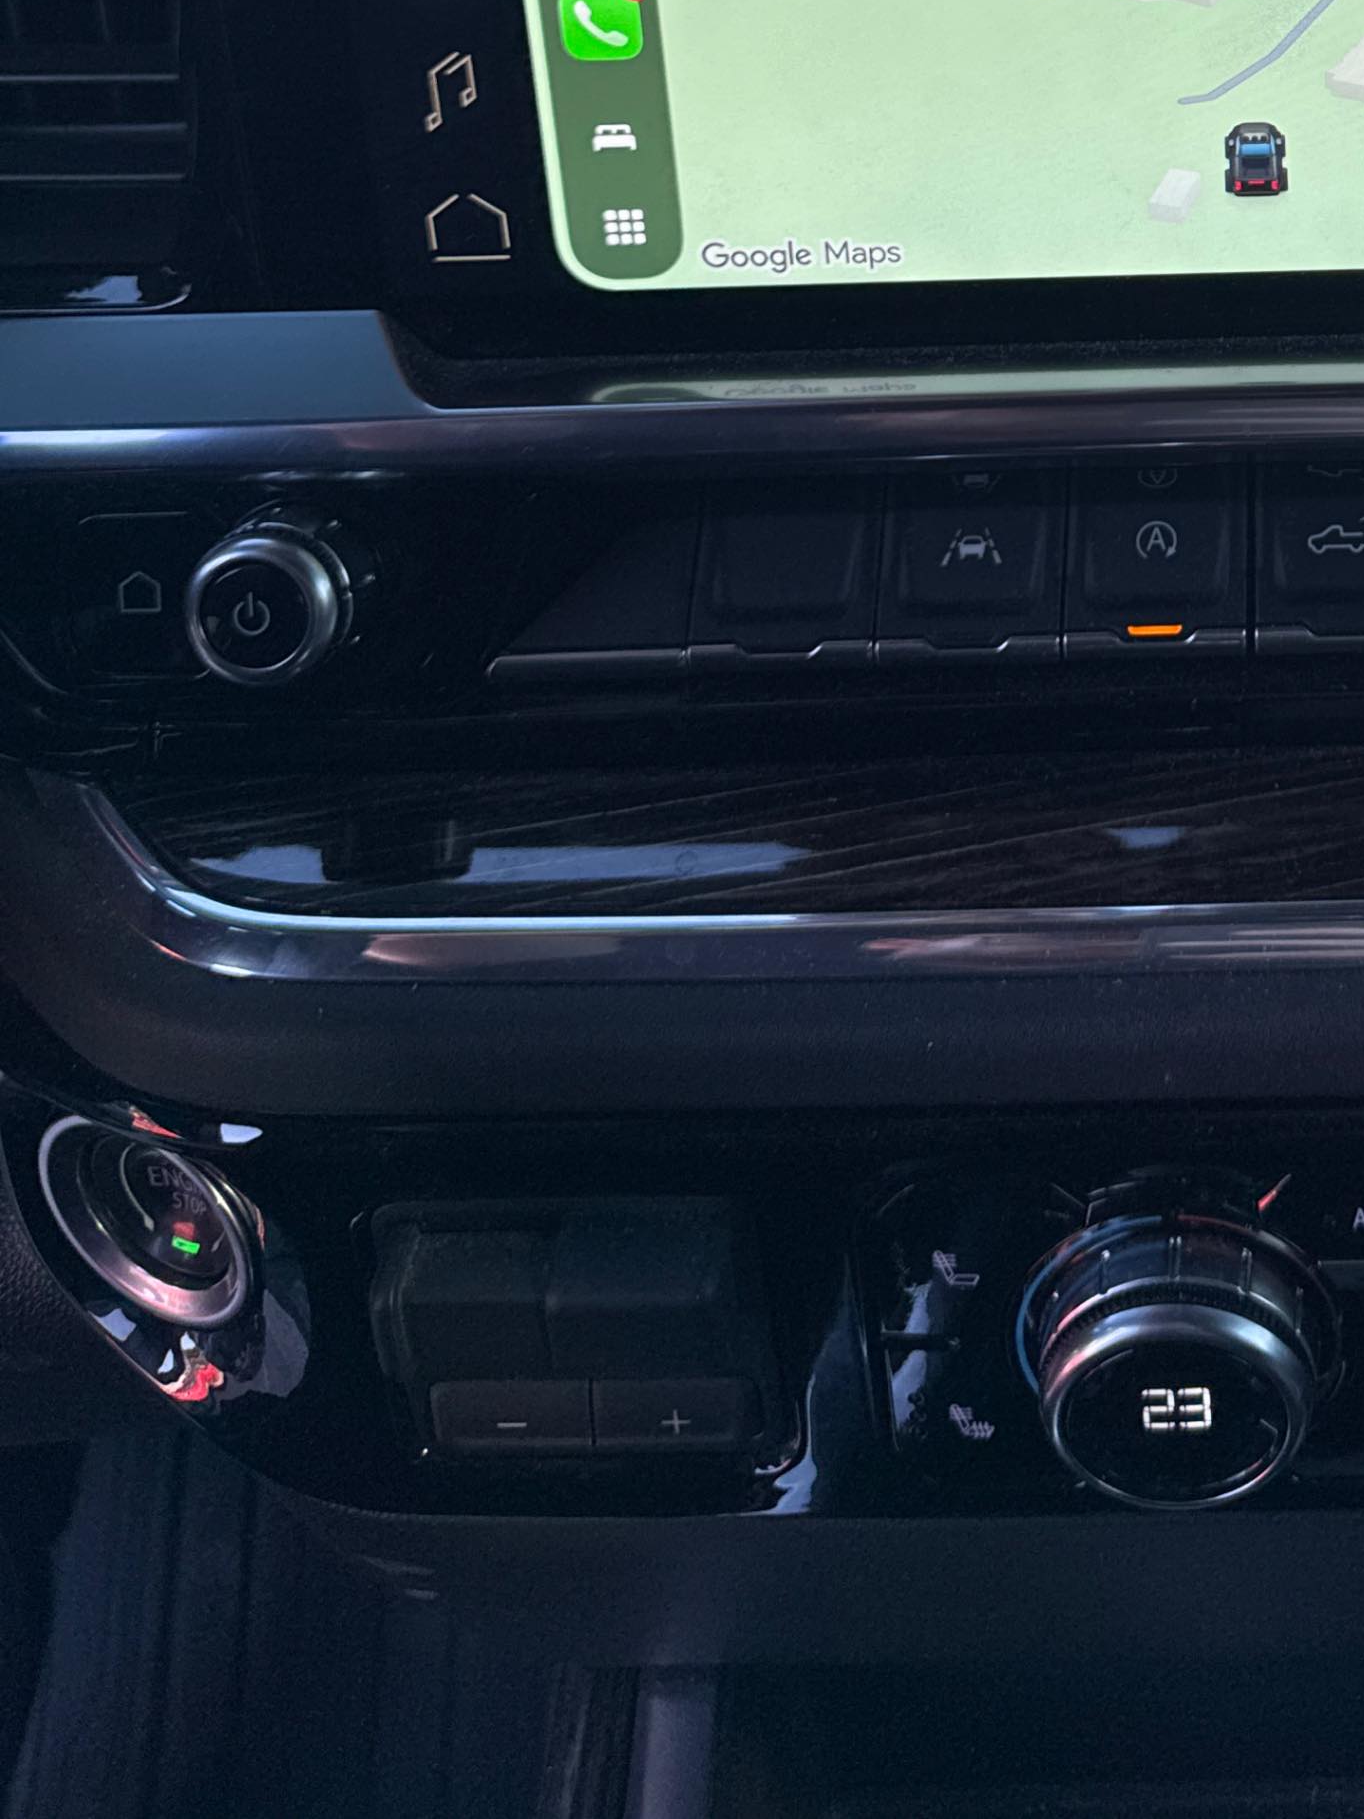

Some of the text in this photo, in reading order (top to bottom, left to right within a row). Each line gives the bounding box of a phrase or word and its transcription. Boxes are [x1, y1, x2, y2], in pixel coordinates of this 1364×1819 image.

[701, 240, 902, 274] Google Maps
[1141, 1386, 1213, 1432] 23
